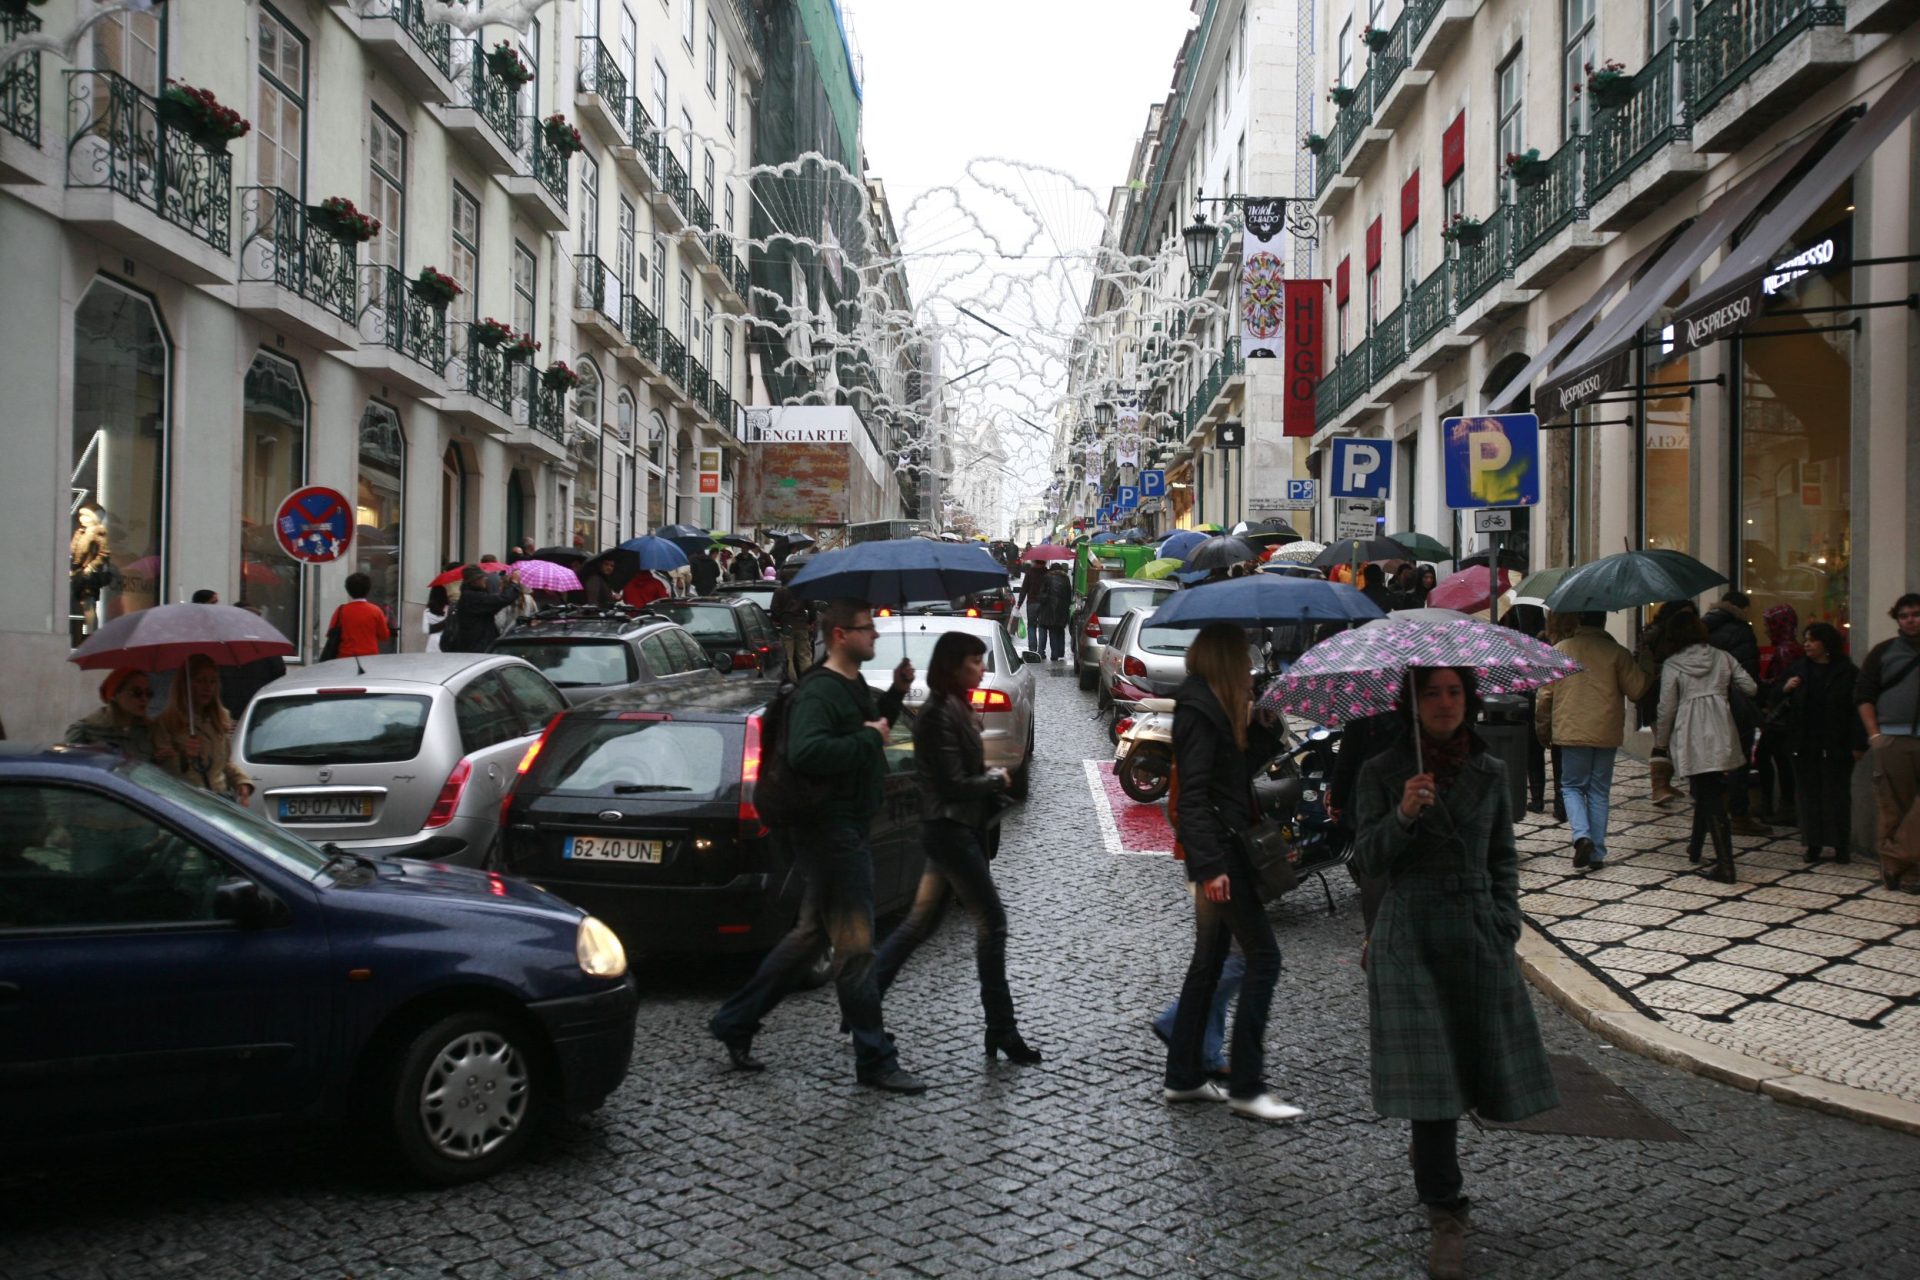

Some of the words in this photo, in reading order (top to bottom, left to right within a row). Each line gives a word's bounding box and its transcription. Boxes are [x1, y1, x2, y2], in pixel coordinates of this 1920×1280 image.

[1684, 296, 1750, 347] NESPRESSO
[1292, 297, 1314, 401] HUGO
[1558, 374, 1601, 412] NESPRESSO
[763, 429, 848, 441] ENGIARTE
[1342, 444, 1381, 492] P
[1469, 432, 1512, 497] P
[1122, 488, 1134, 505] P
[1144, 473, 1159, 495] P
[1290, 482, 1303, 499] P
